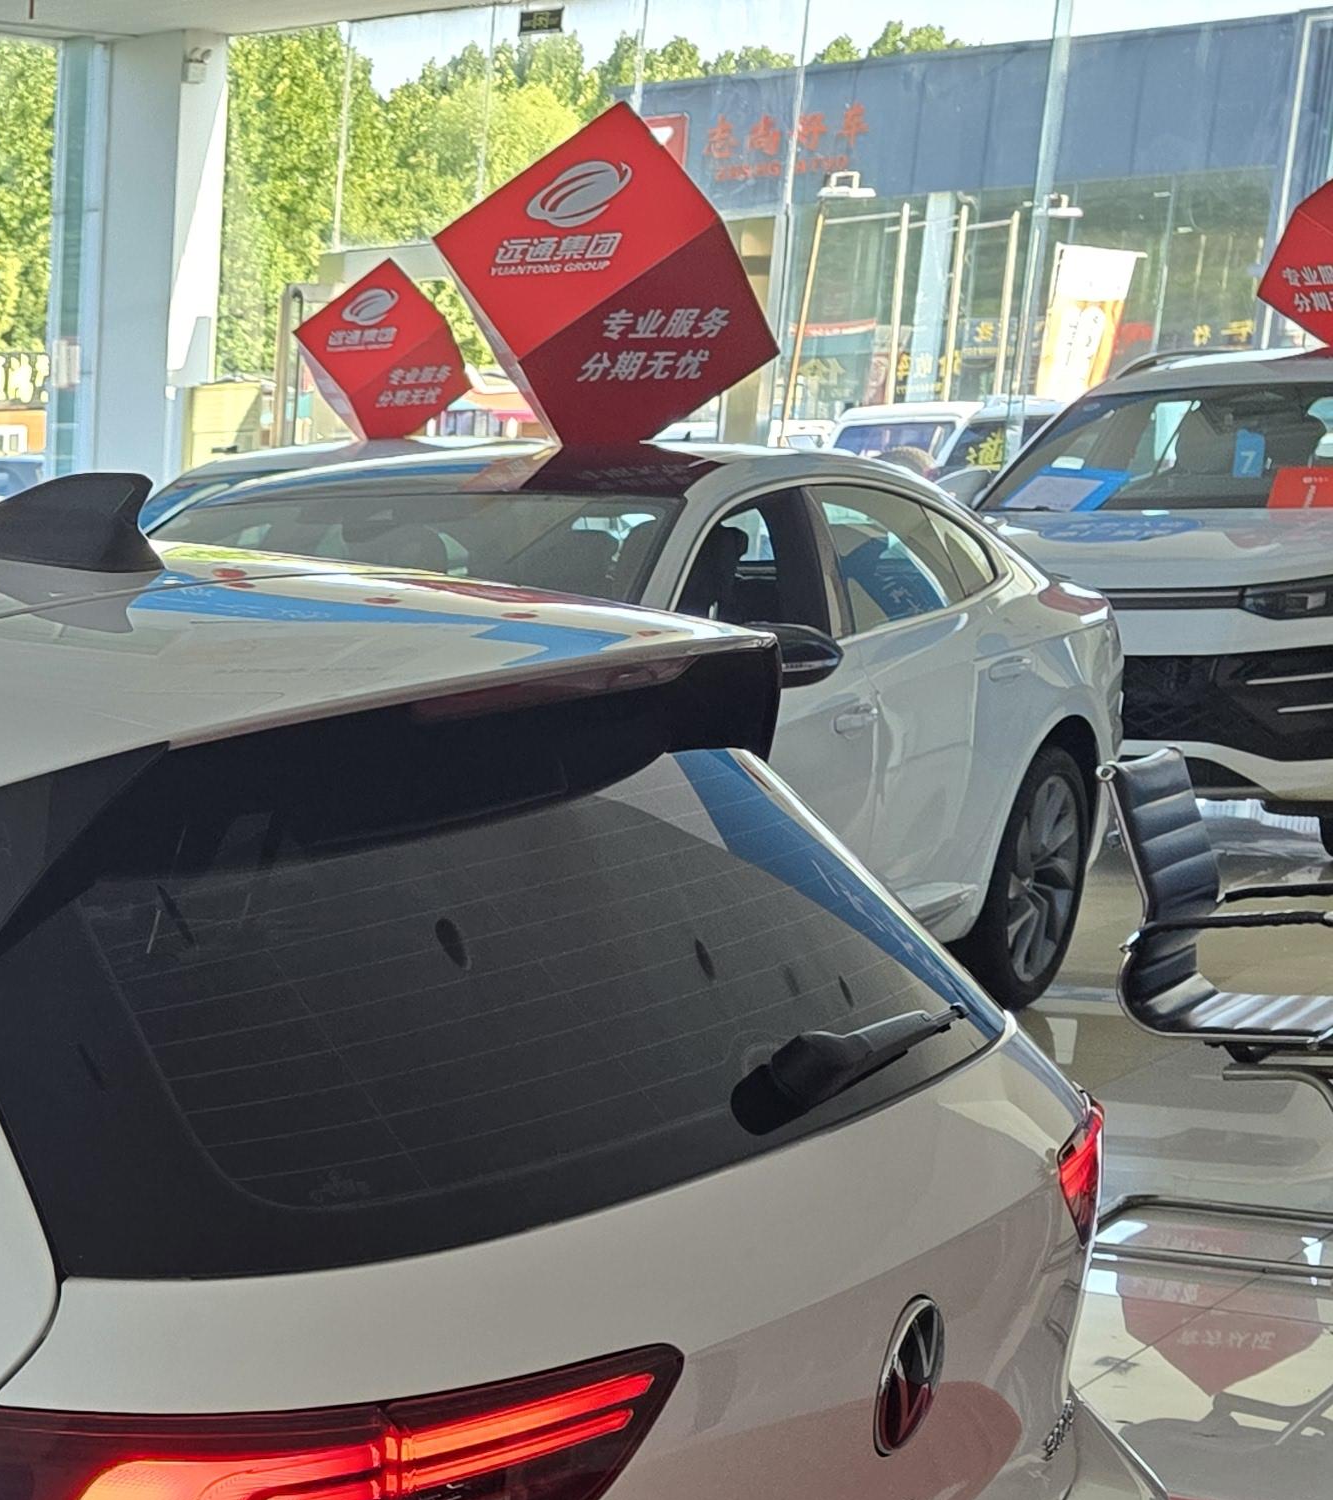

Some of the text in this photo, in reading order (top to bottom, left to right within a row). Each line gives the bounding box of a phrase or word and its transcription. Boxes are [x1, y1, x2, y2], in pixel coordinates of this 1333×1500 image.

[494, 231, 623, 264] 远通集团
[563, 259, 611, 273] GROUP
[1293, 290, 1333, 313] 分期
[601, 306, 730, 341] 专业服务
[576, 348, 711, 382] 分期无忧
